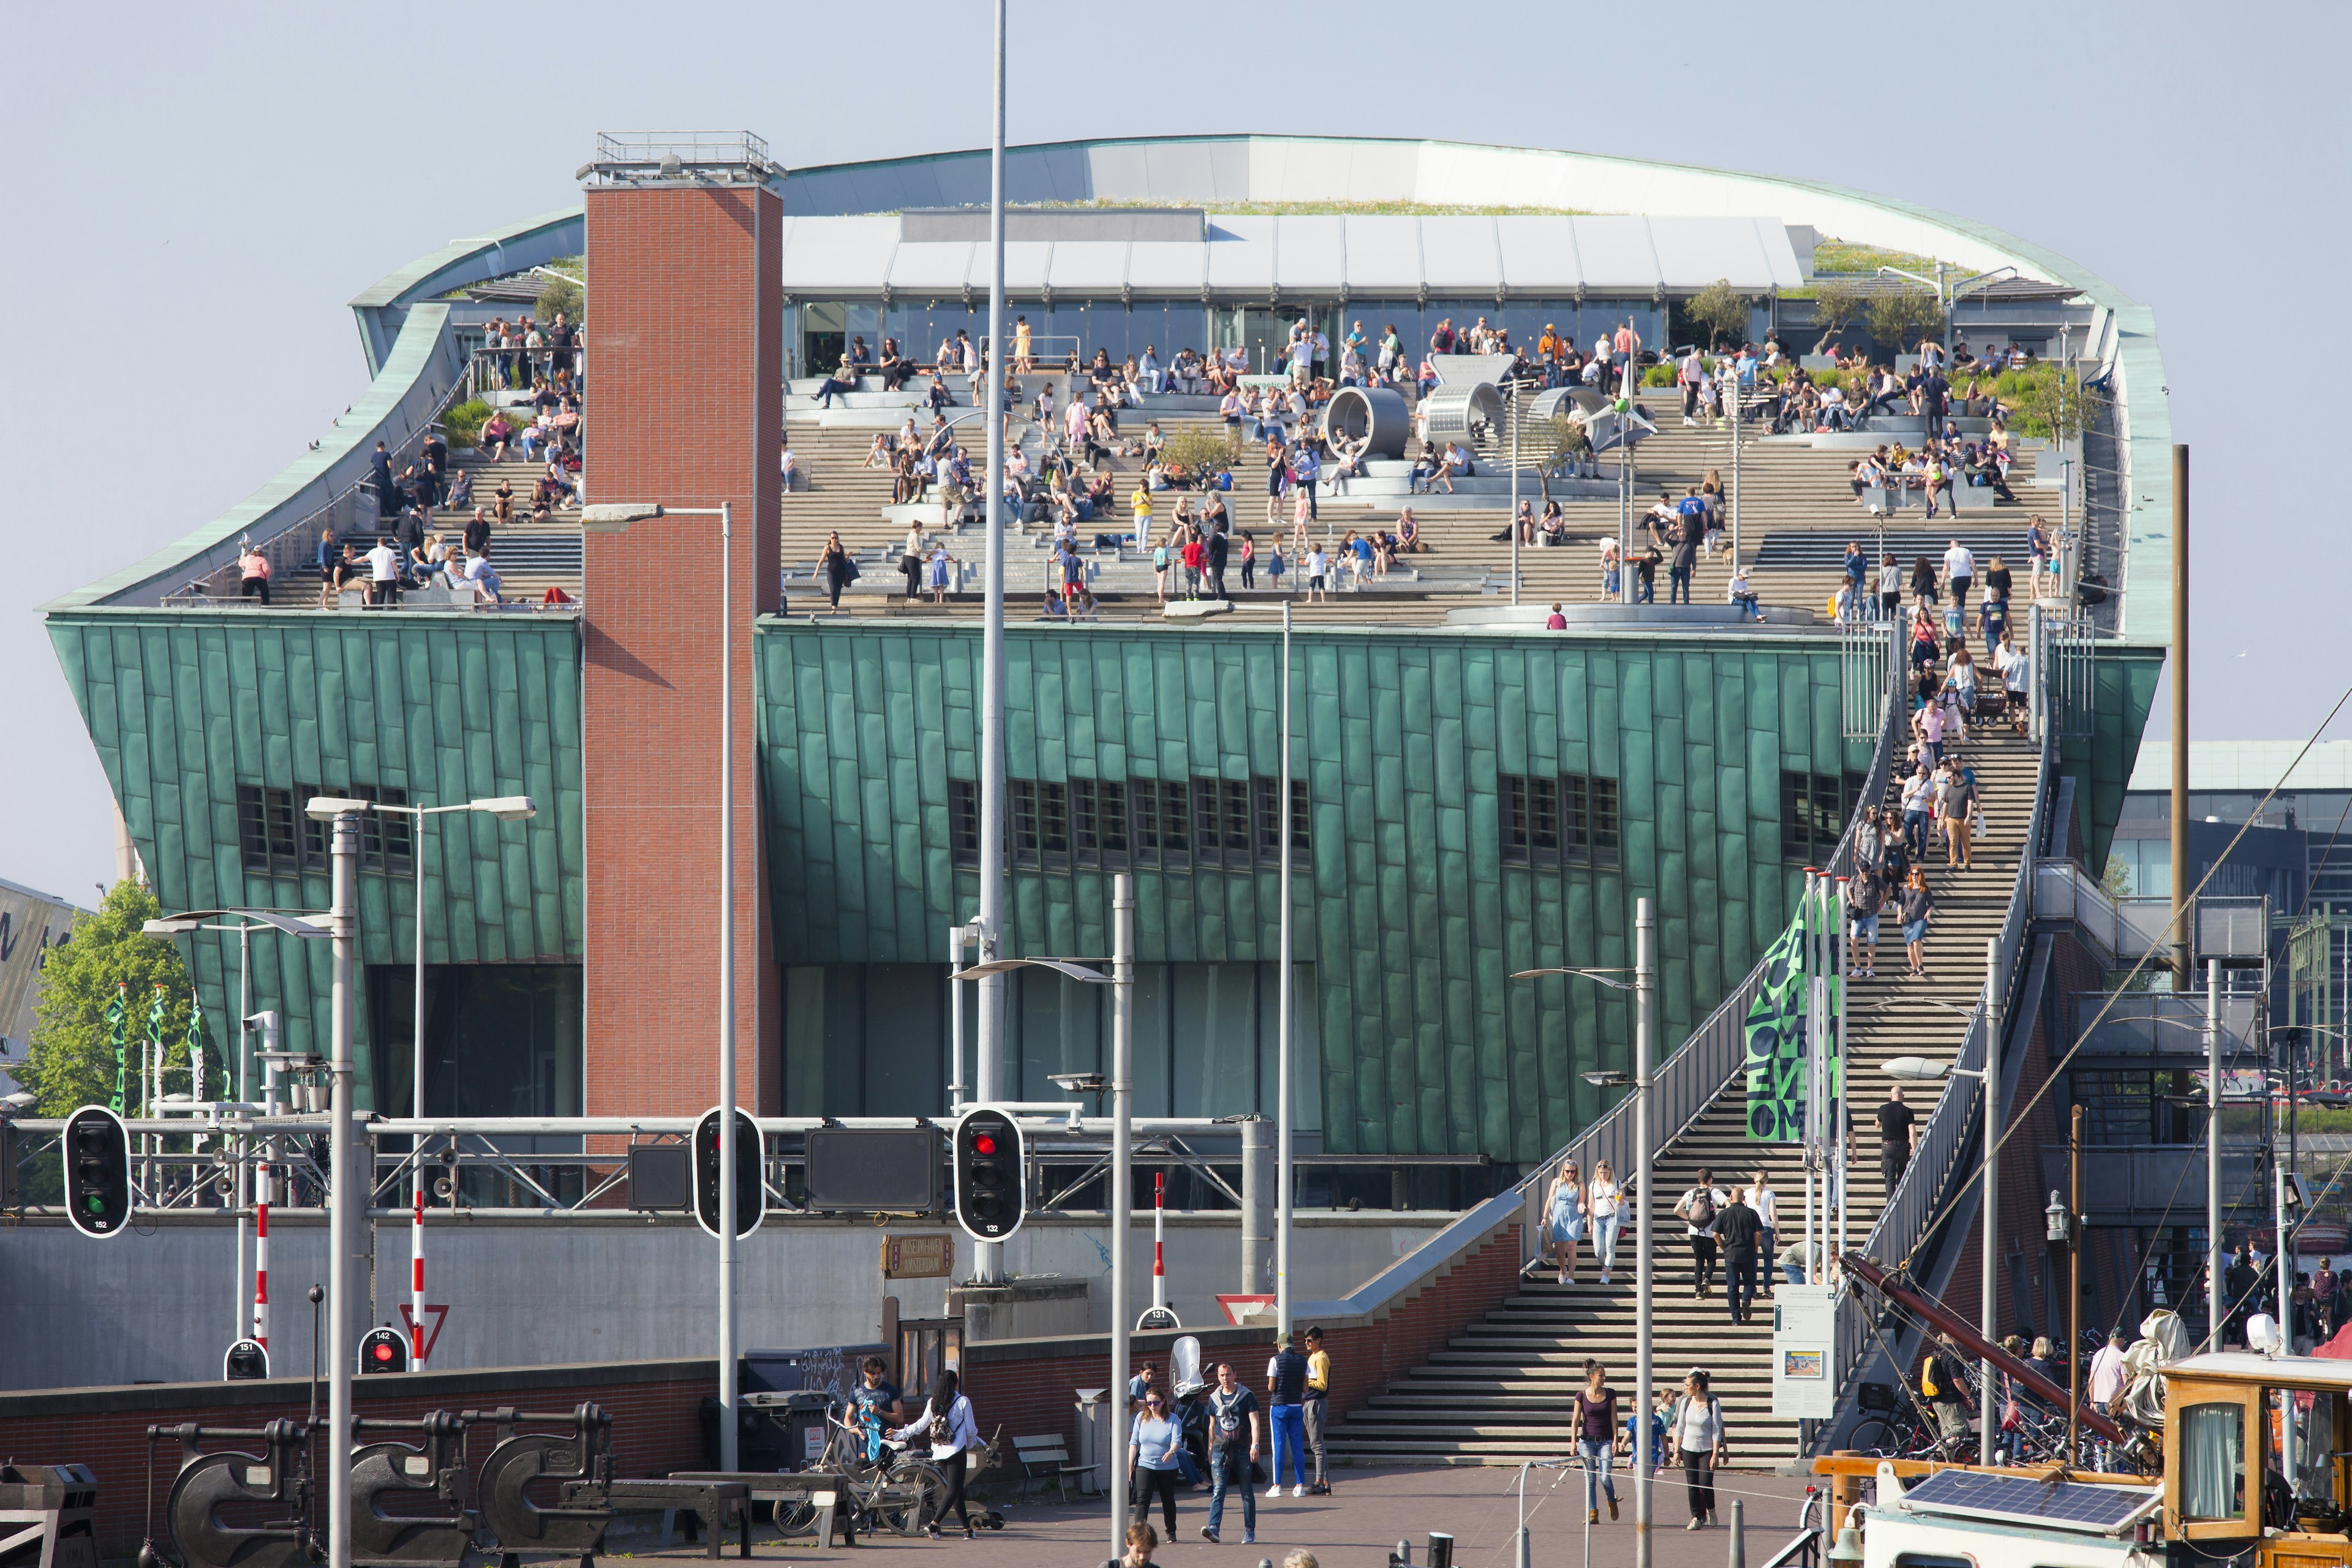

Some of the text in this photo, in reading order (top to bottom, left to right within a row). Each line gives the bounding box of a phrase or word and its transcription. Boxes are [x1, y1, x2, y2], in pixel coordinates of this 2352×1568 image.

[851, 1140, 890, 1155] STOP
[901, 1238, 943, 1254] MUSEUMHAVEN
[904, 1257, 940, 1273] AMSTERDAM
